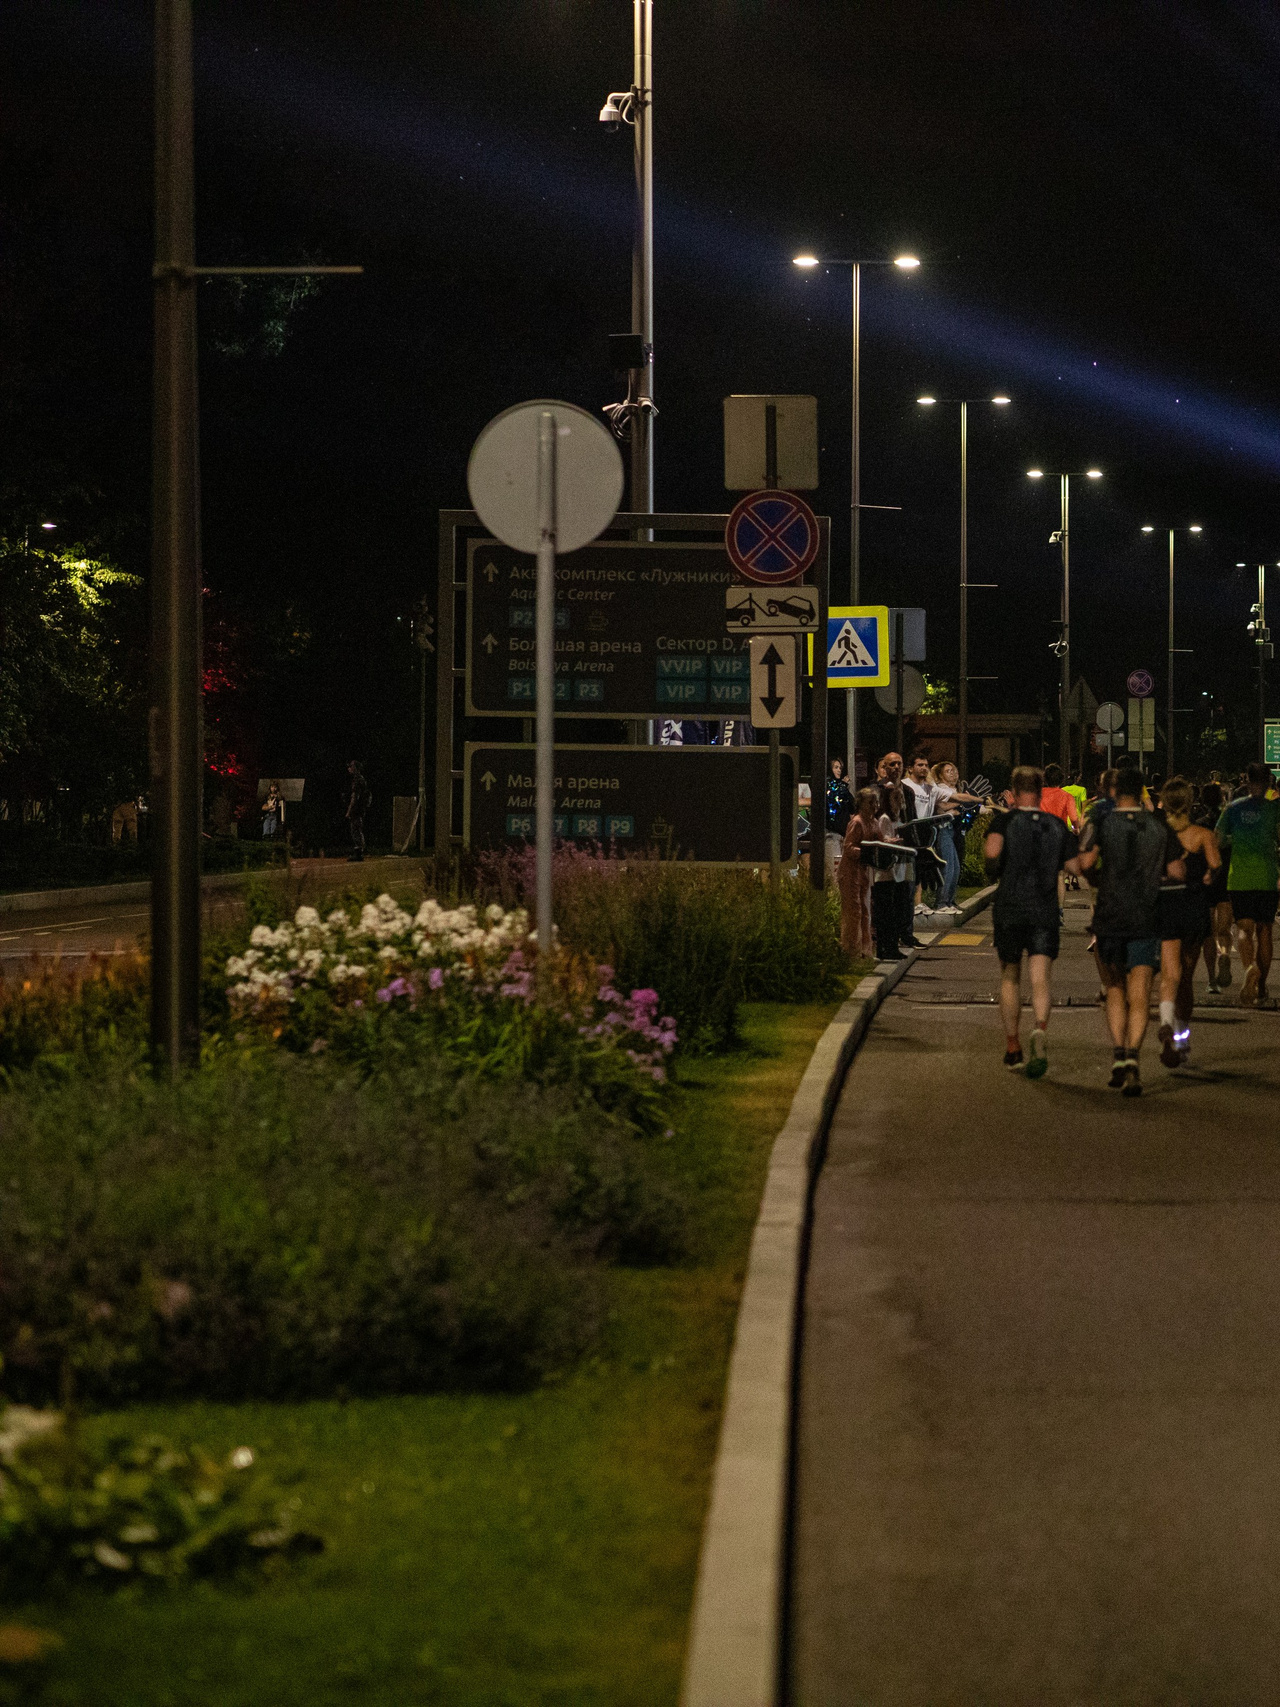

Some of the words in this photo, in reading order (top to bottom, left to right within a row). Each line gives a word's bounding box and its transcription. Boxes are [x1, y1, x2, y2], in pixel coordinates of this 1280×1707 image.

[509, 565, 636, 581] Аквкомплекс
[640, 568, 741, 584] «Лужники»
[567, 587, 616, 601] Center
[508, 637, 586, 652] Болшая
[589, 640, 642, 656] арена
[656, 636, 718, 654] Сектор
[722, 637, 736, 653] D,
[507, 656, 570, 674] Bolsya
[573, 657, 615, 672] Arena
[660, 659, 703, 673] VVIP
[713, 660, 743, 673] VIP
[511, 682, 532, 697] P1
[578, 684, 599, 698] P3
[666, 685, 696, 698] VIP
[712, 685, 742, 698] VIP
[506, 774, 564, 788] Мая
[567, 776, 620, 792] арена
[560, 796, 602, 808] Arena
[511, 817, 530, 831] P6
[577, 817, 597, 832] P8
[610, 818, 630, 833] P9
